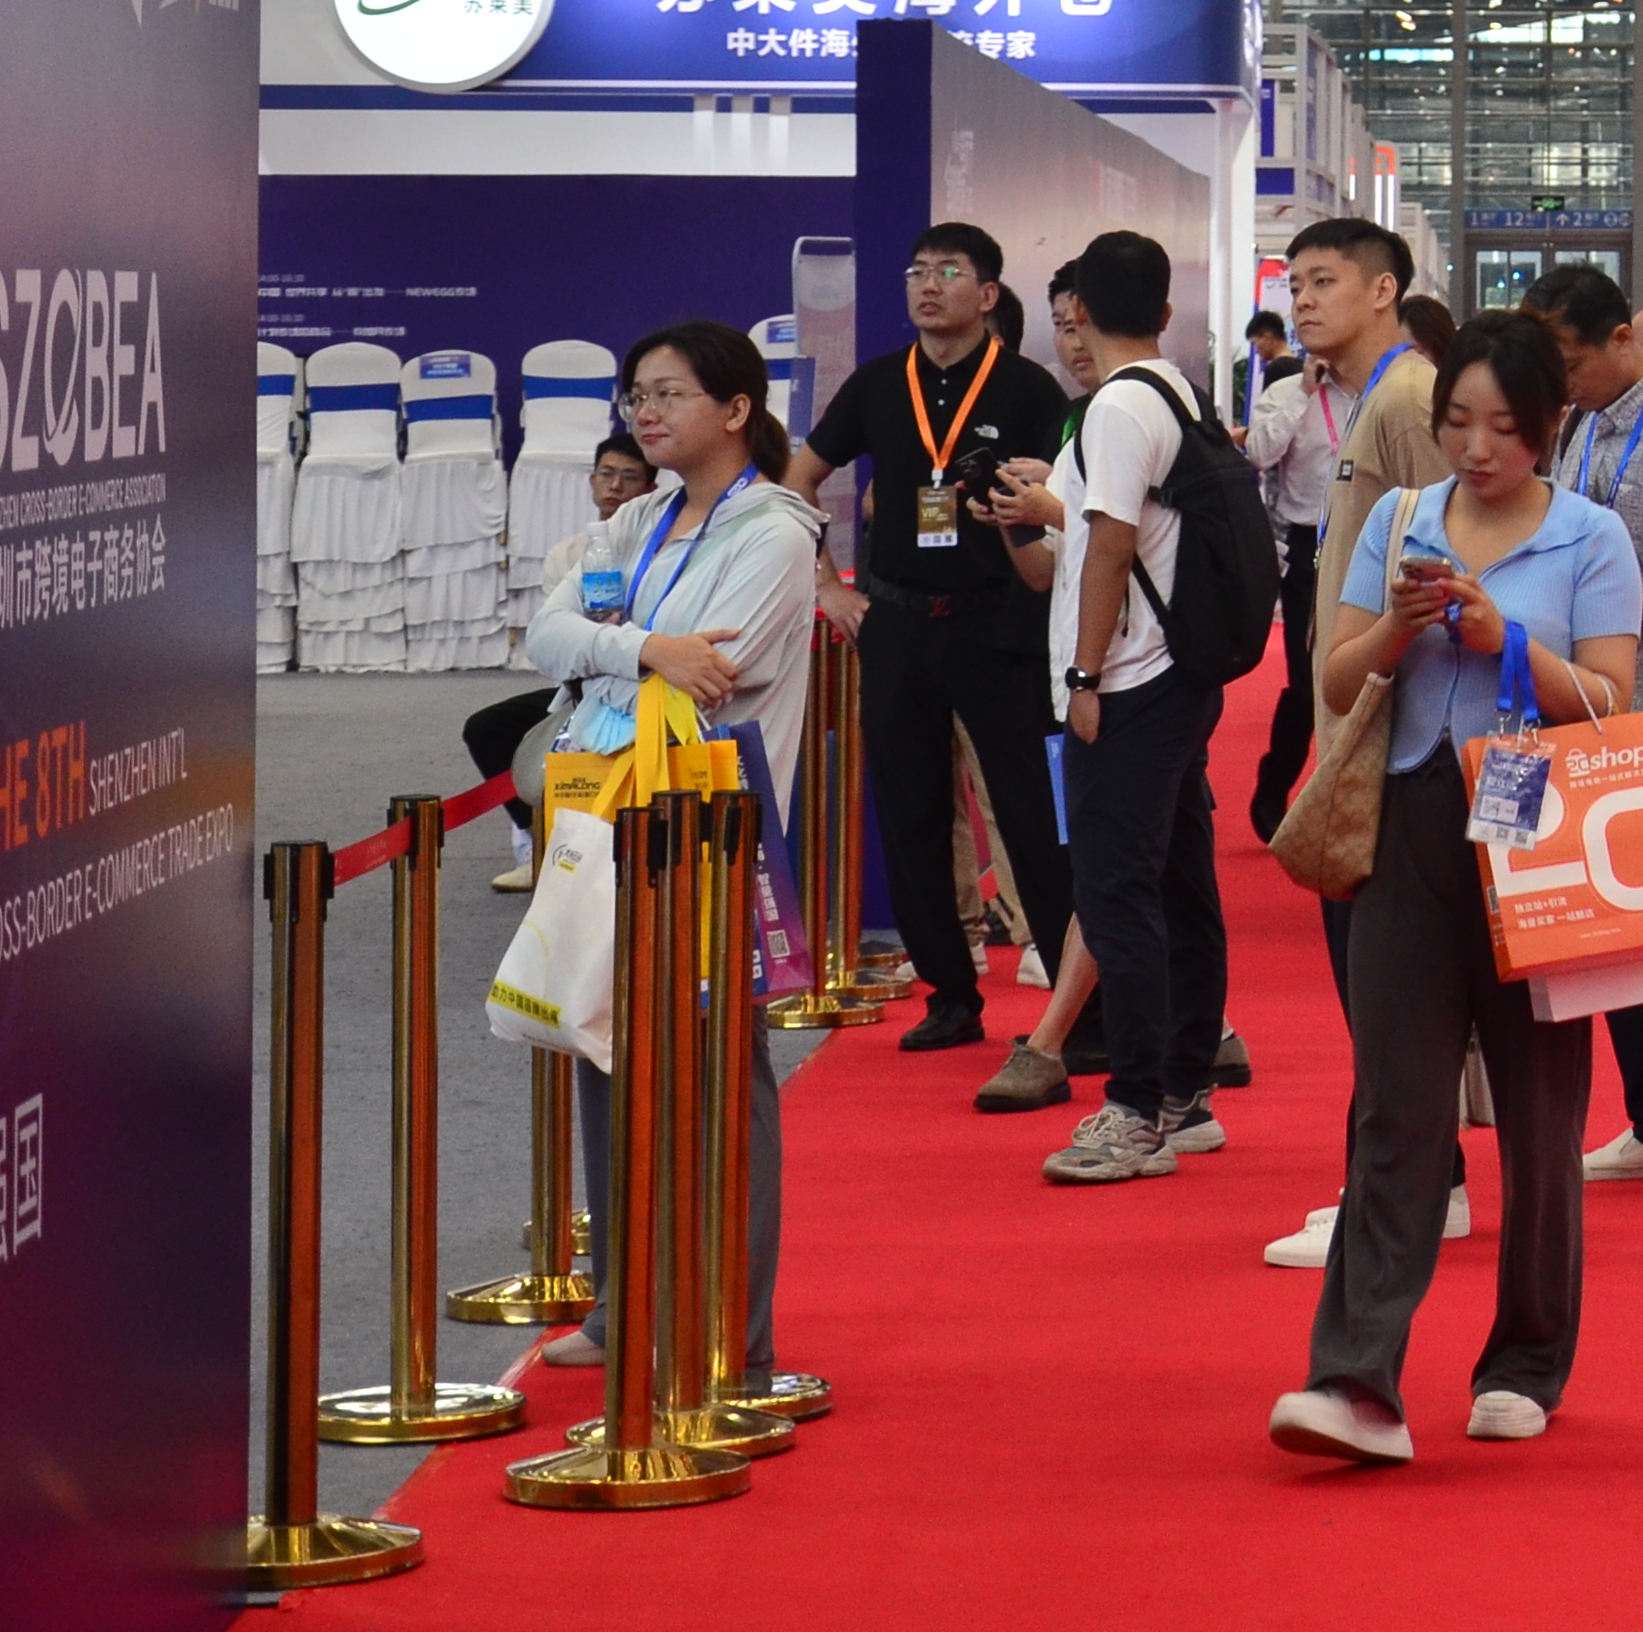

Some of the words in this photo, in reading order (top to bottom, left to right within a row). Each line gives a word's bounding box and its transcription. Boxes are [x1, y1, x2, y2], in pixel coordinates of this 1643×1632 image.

[726, 28, 1036, 59] 中大件海专家
[35, 721, 86, 839] 8TH
[89, 741, 156, 816] SHENZHEN
[0, 869, 82, 961] SS-BORDER
[85, 831, 166, 920] E-COMMERCE
[168, 816, 204, 880] TRADE
[206, 803, 234, 862] EXPO
